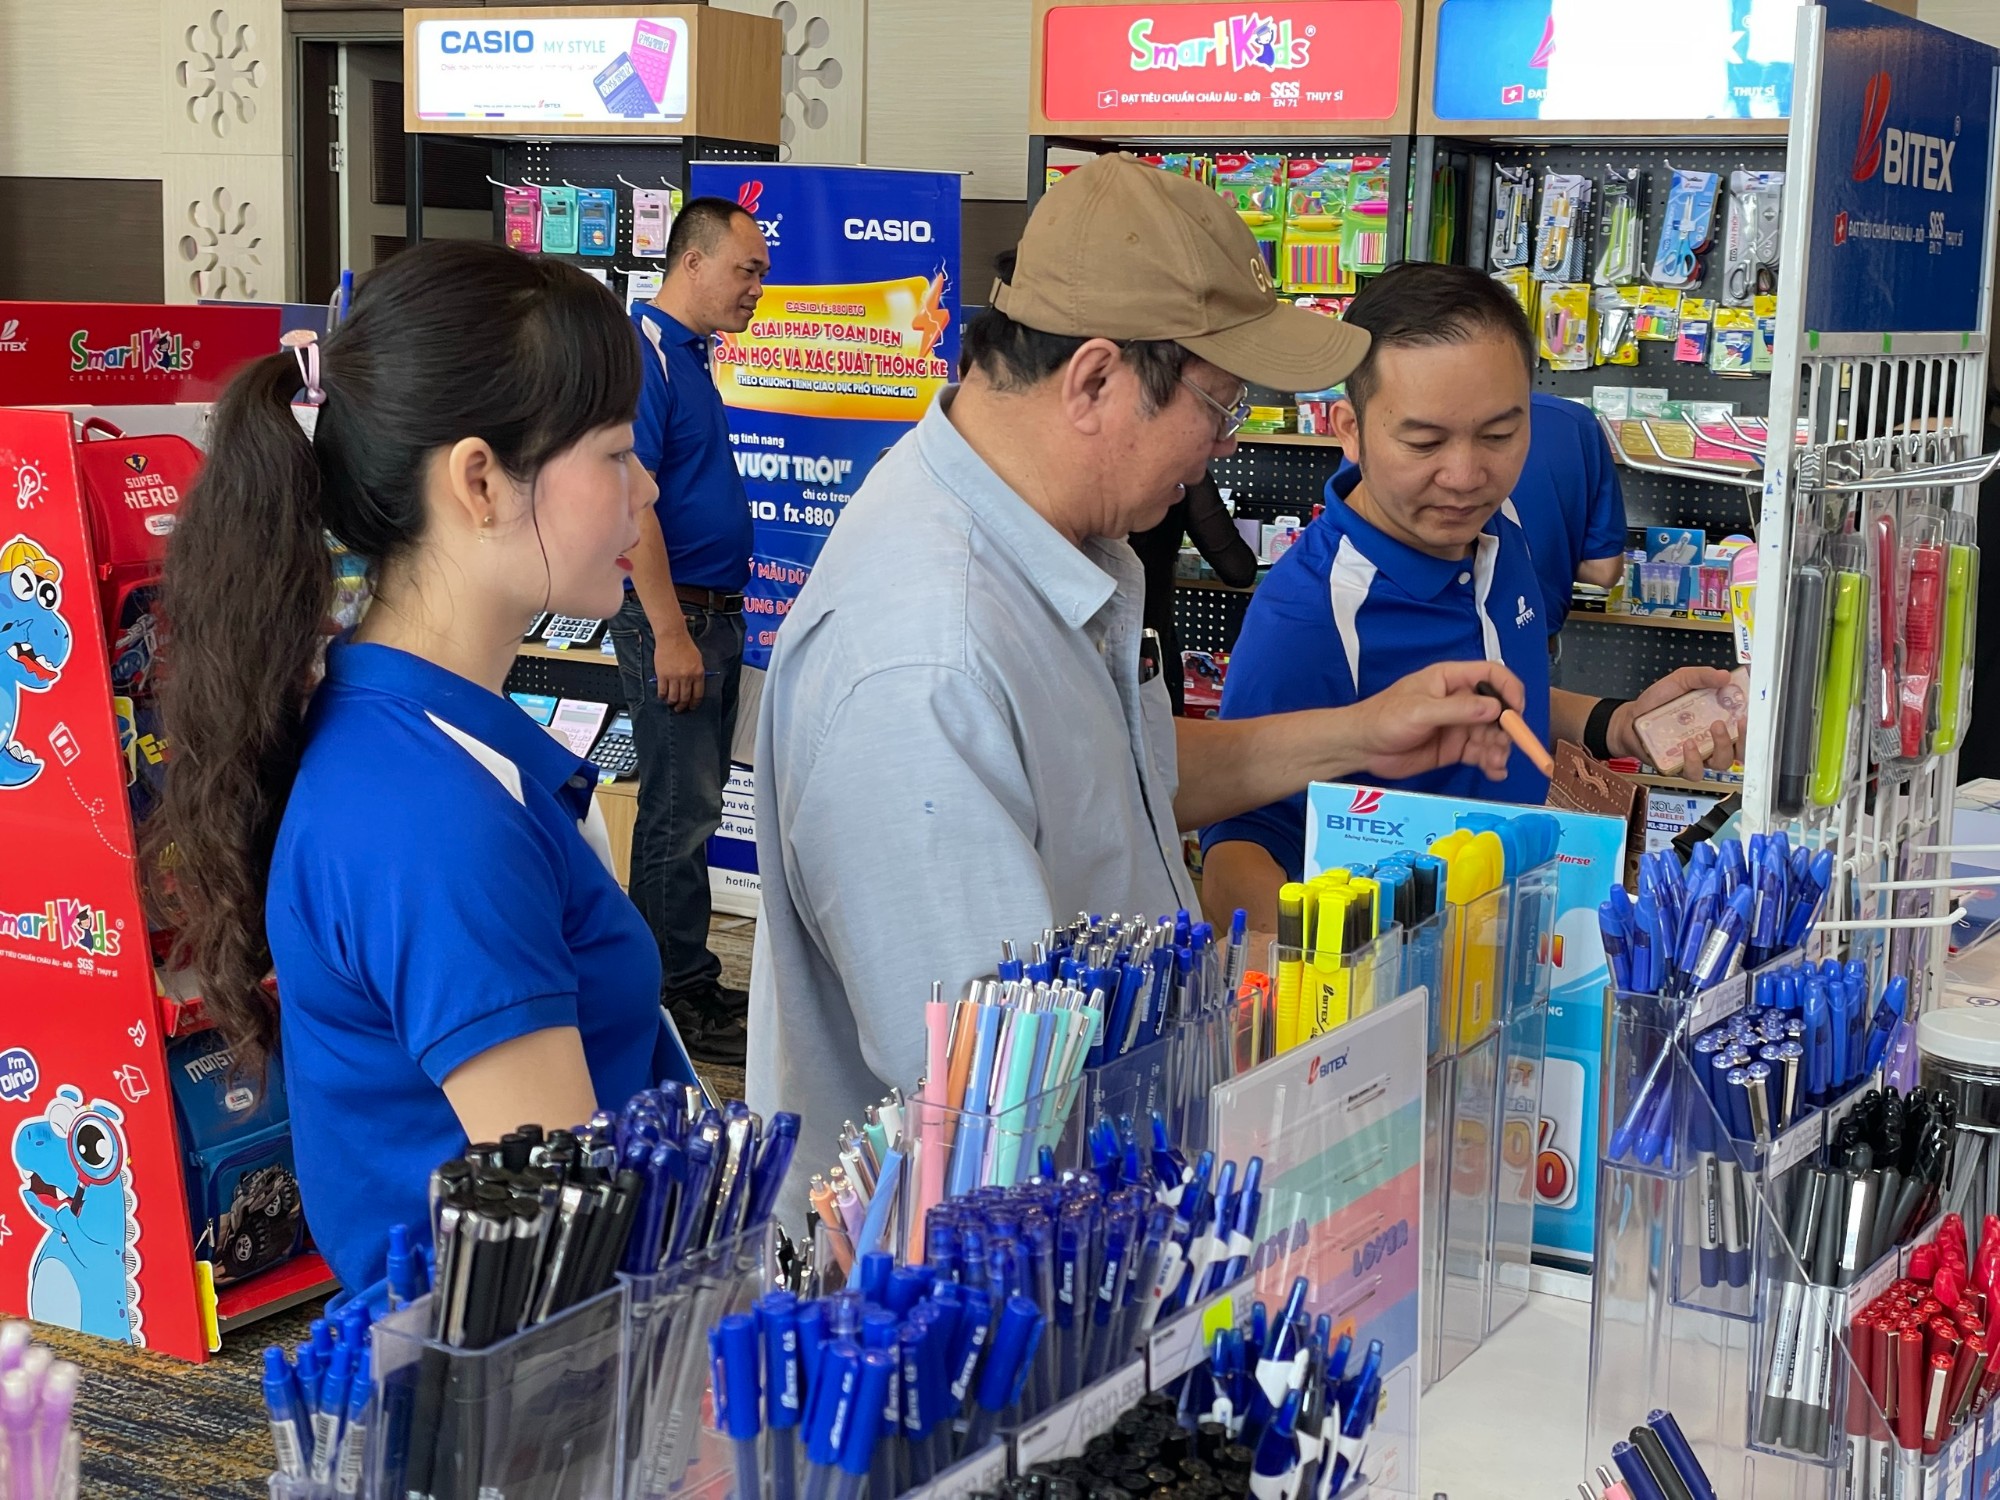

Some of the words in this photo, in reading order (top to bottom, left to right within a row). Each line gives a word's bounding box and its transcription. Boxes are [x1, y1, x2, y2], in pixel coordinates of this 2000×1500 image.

[441, 30, 534, 54] CASIO
[544, 41, 565, 53] MY
[567, 40, 606, 53] STYLE
[1140, 92, 1161, 103] TIÊU
[1196, 91, 1223, 103] CHÂU
[1223, 90, 1238, 102] ÂU
[1306, 91, 1332, 103] THỤY
[1270, 81, 1299, 98] SGS
[1273, 99, 1286, 107] EN
[1287, 99, 1298, 107] 71
[1884, 128, 1956, 193] BITEX
[844, 218, 931, 243] CASIO
[1929, 211, 1944, 239] SGS
[785, 302, 818, 312] CASIO
[820, 303, 846, 315] fx-880
[848, 305, 865, 316] BTG
[750, 346, 781, 370] HỌC
[70, 374, 136, 382] CREATING
[737, 375, 757, 386] THEO
[125, 474, 164, 488] SUPER
[123, 486, 180, 509] HERO
[783, 501, 835, 527] fx-880
[743, 597, 774, 614] UNG
[1741, 627, 1749, 650] BITEX
[1650, 800, 1684, 814] KOLA
[1649, 812, 1685, 820] LABELER
[1326, 814, 1405, 837] BITEX
[725, 876, 762, 890] hotline
[77, 957, 94, 970] SGS
[1321, 994, 1329, 1023] BITEX
[7, 1056, 27, 1070] I'm
[1320, 1053, 1348, 1078] BITEX
[0, 1068, 34, 1092] Dino
